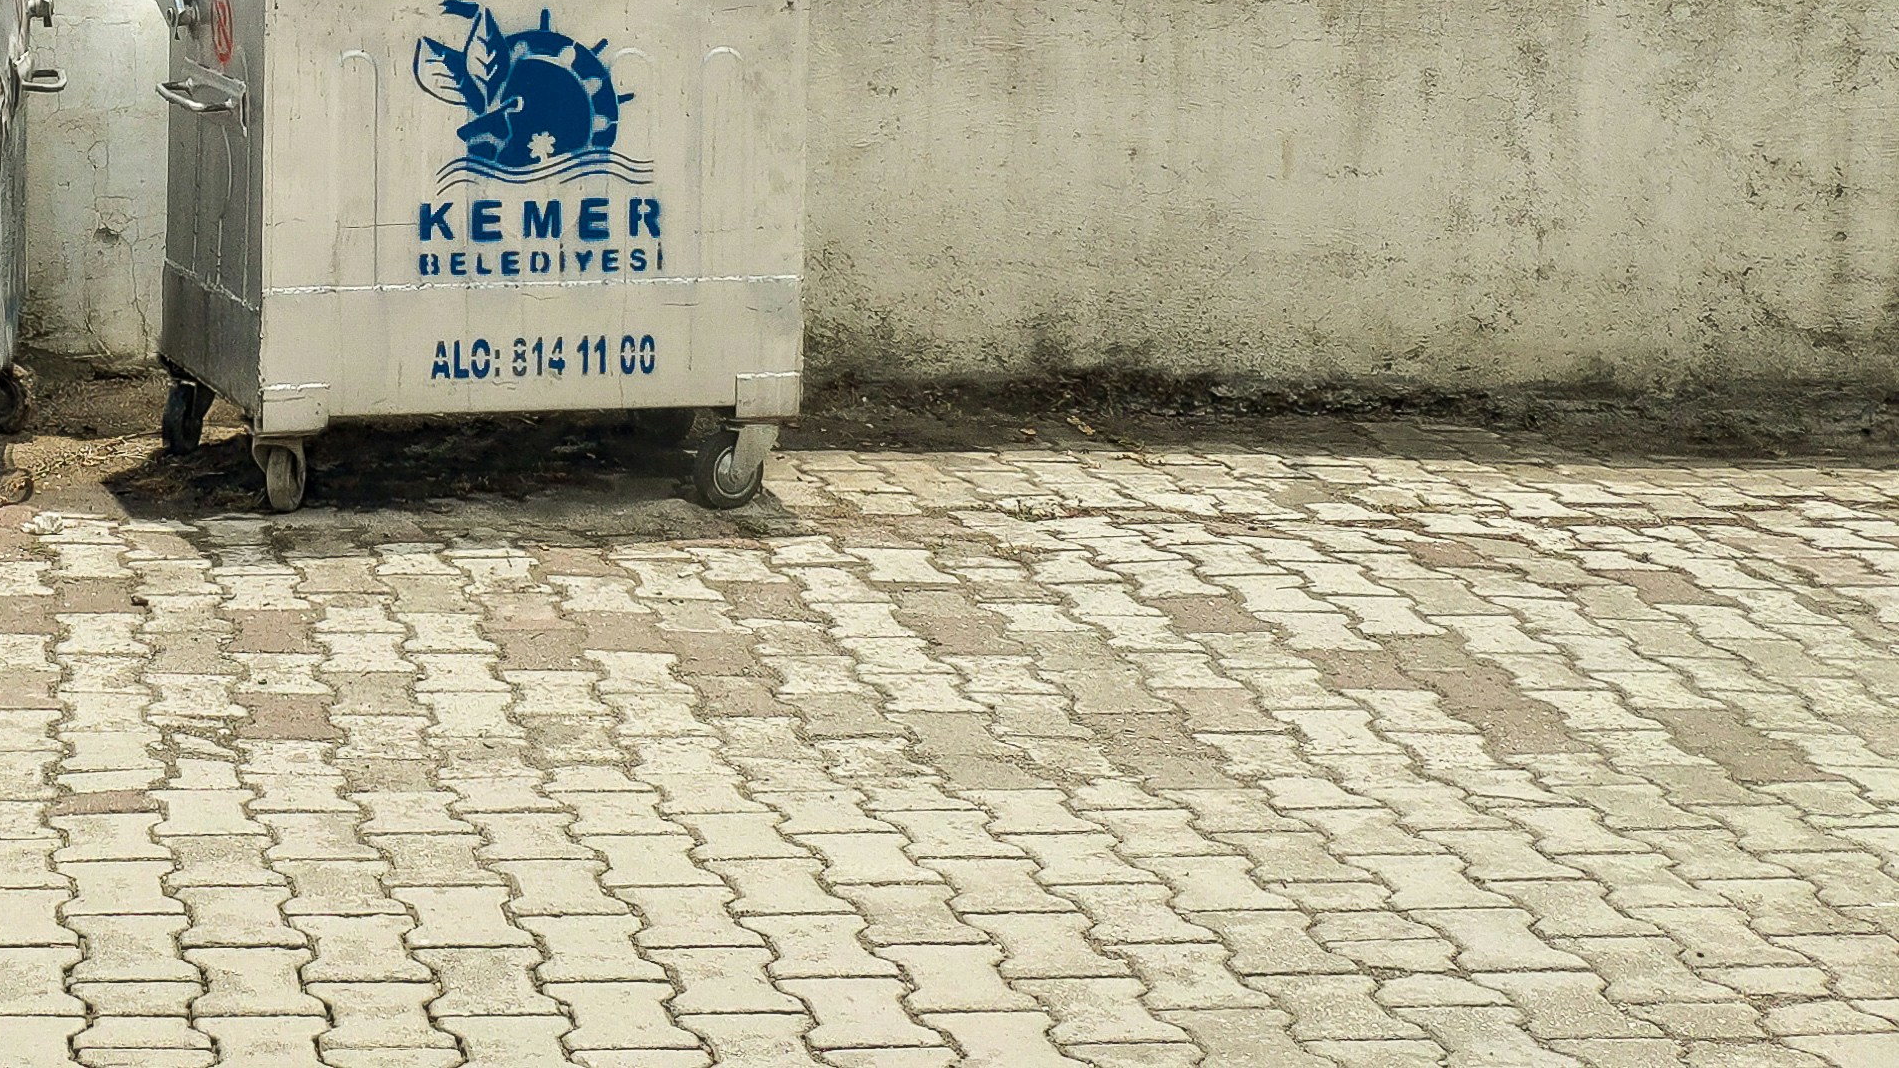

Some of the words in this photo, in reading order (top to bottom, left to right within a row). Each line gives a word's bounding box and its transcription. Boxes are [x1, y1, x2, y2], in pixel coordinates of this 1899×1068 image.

[418, 197, 662, 242] KEMER
[419, 242, 664, 277] BELEDİYESİ
[431, 338, 501, 379] ALO:
[512, 336, 566, 377] 814
[576, 334, 607, 376] 11
[620, 334, 656, 375] 00
